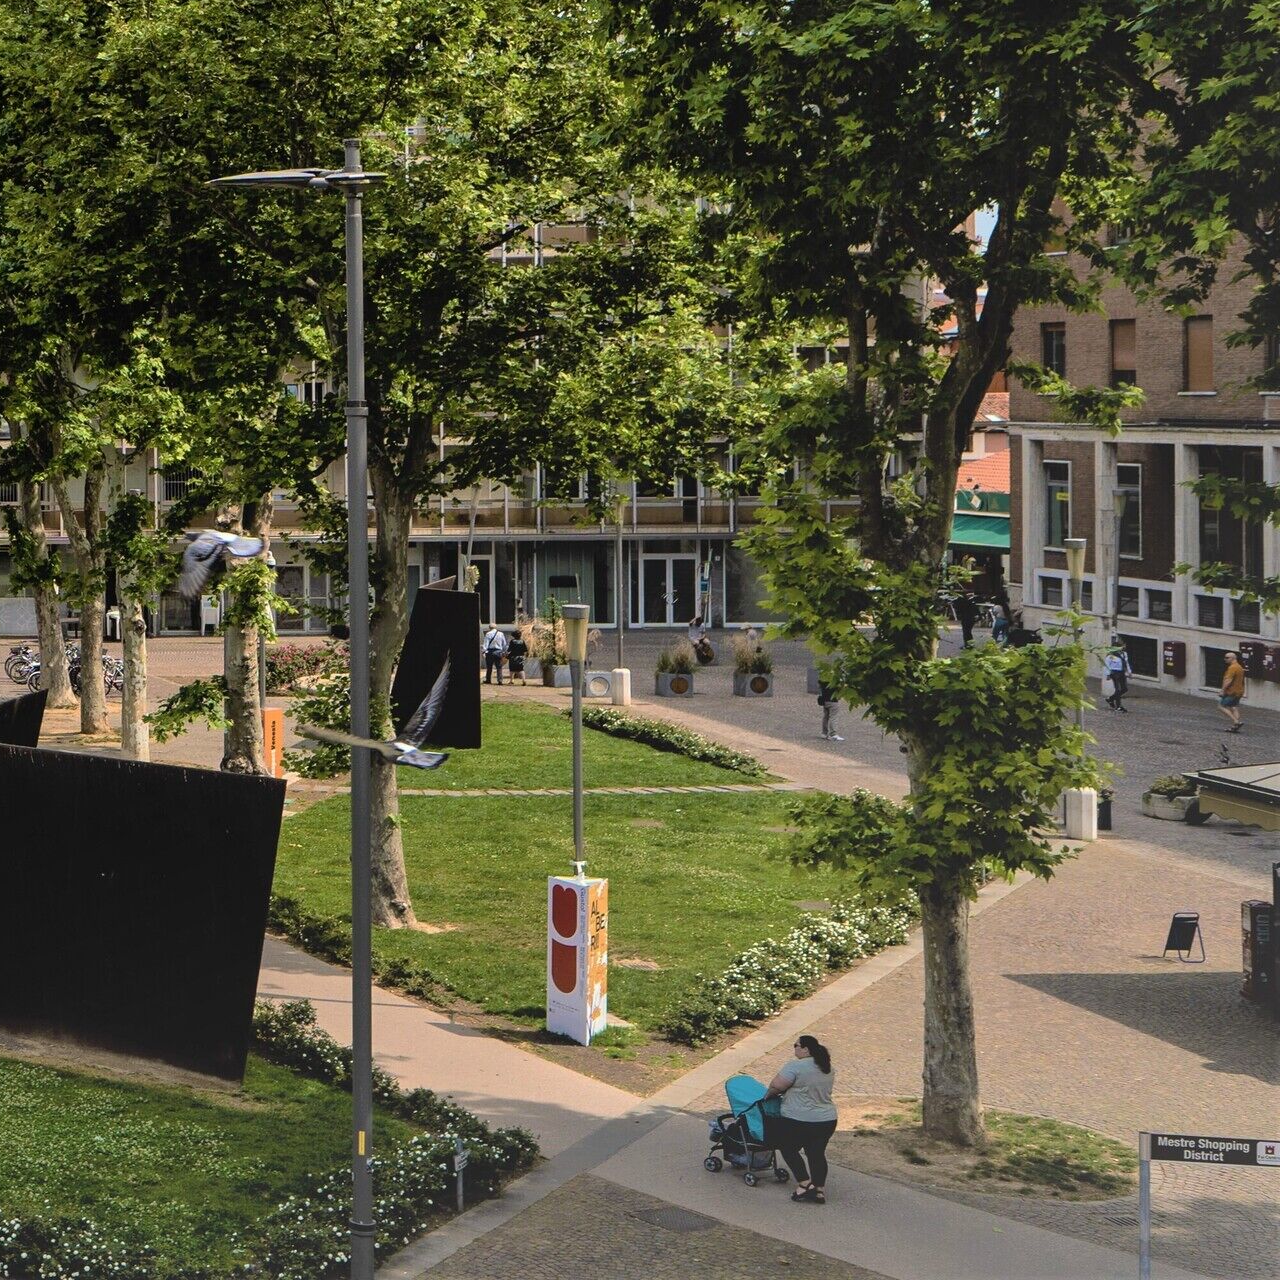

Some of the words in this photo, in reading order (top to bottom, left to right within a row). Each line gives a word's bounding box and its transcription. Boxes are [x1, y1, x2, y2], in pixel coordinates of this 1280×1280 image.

[1157, 1136, 1196, 1148] Mestre
[1198, 1138, 1250, 1153] Shopping
[1183, 1149, 1224, 1162] District
